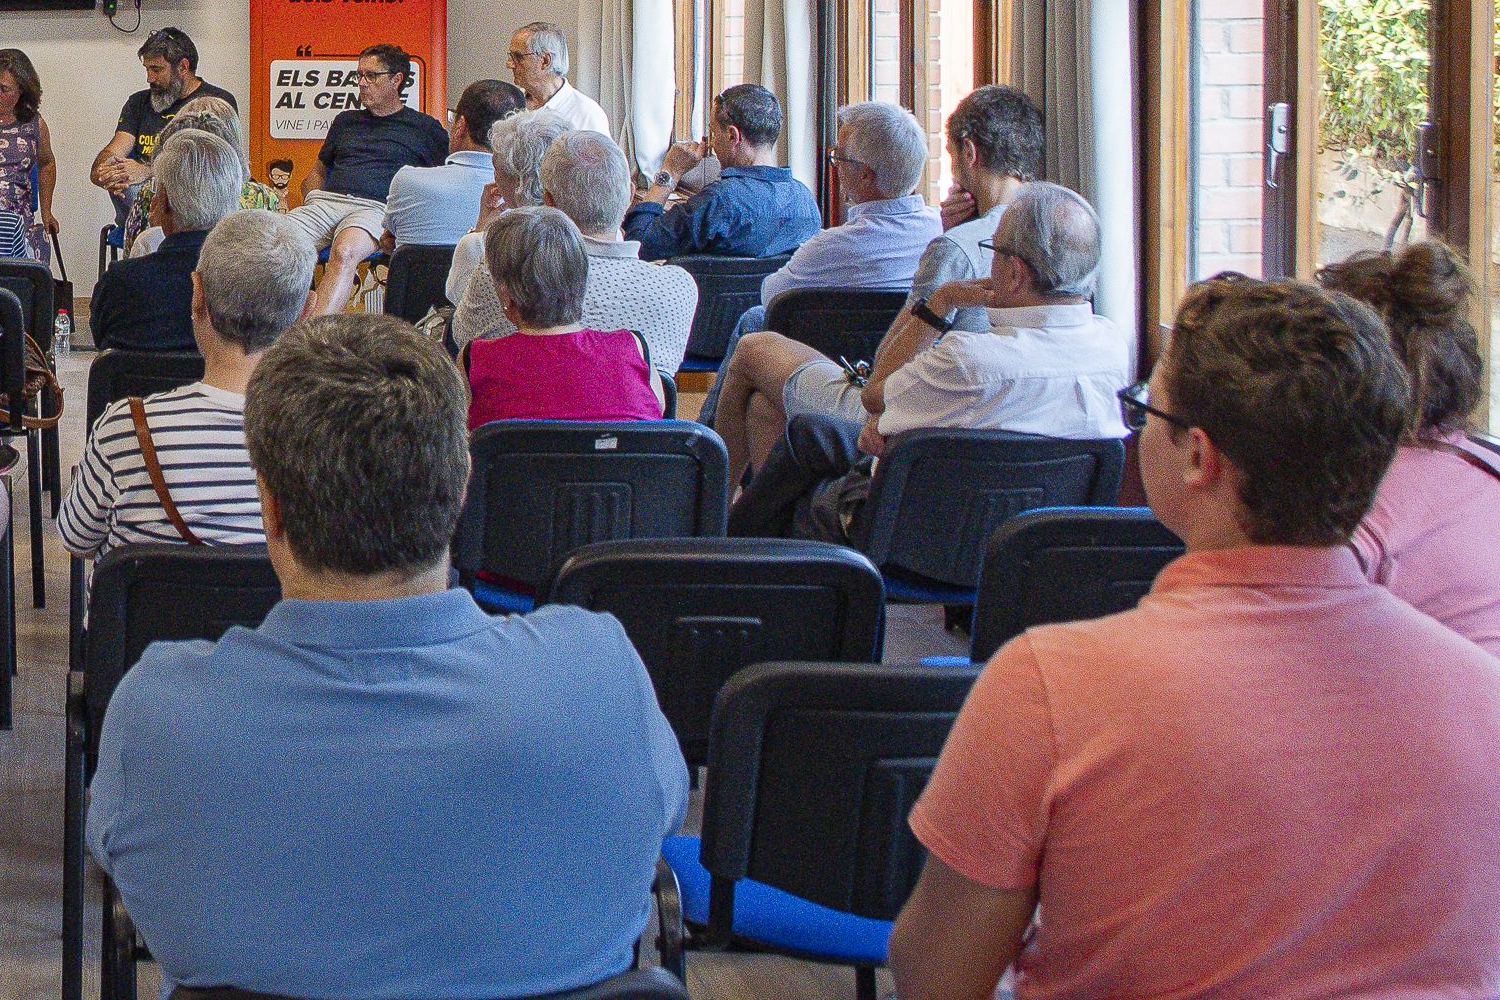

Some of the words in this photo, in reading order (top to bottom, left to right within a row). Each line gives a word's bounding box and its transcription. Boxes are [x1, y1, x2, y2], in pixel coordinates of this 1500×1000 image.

[276, 70, 320, 87] ELS
[275, 92, 306, 109] AL
[275, 119, 305, 131] VINE
